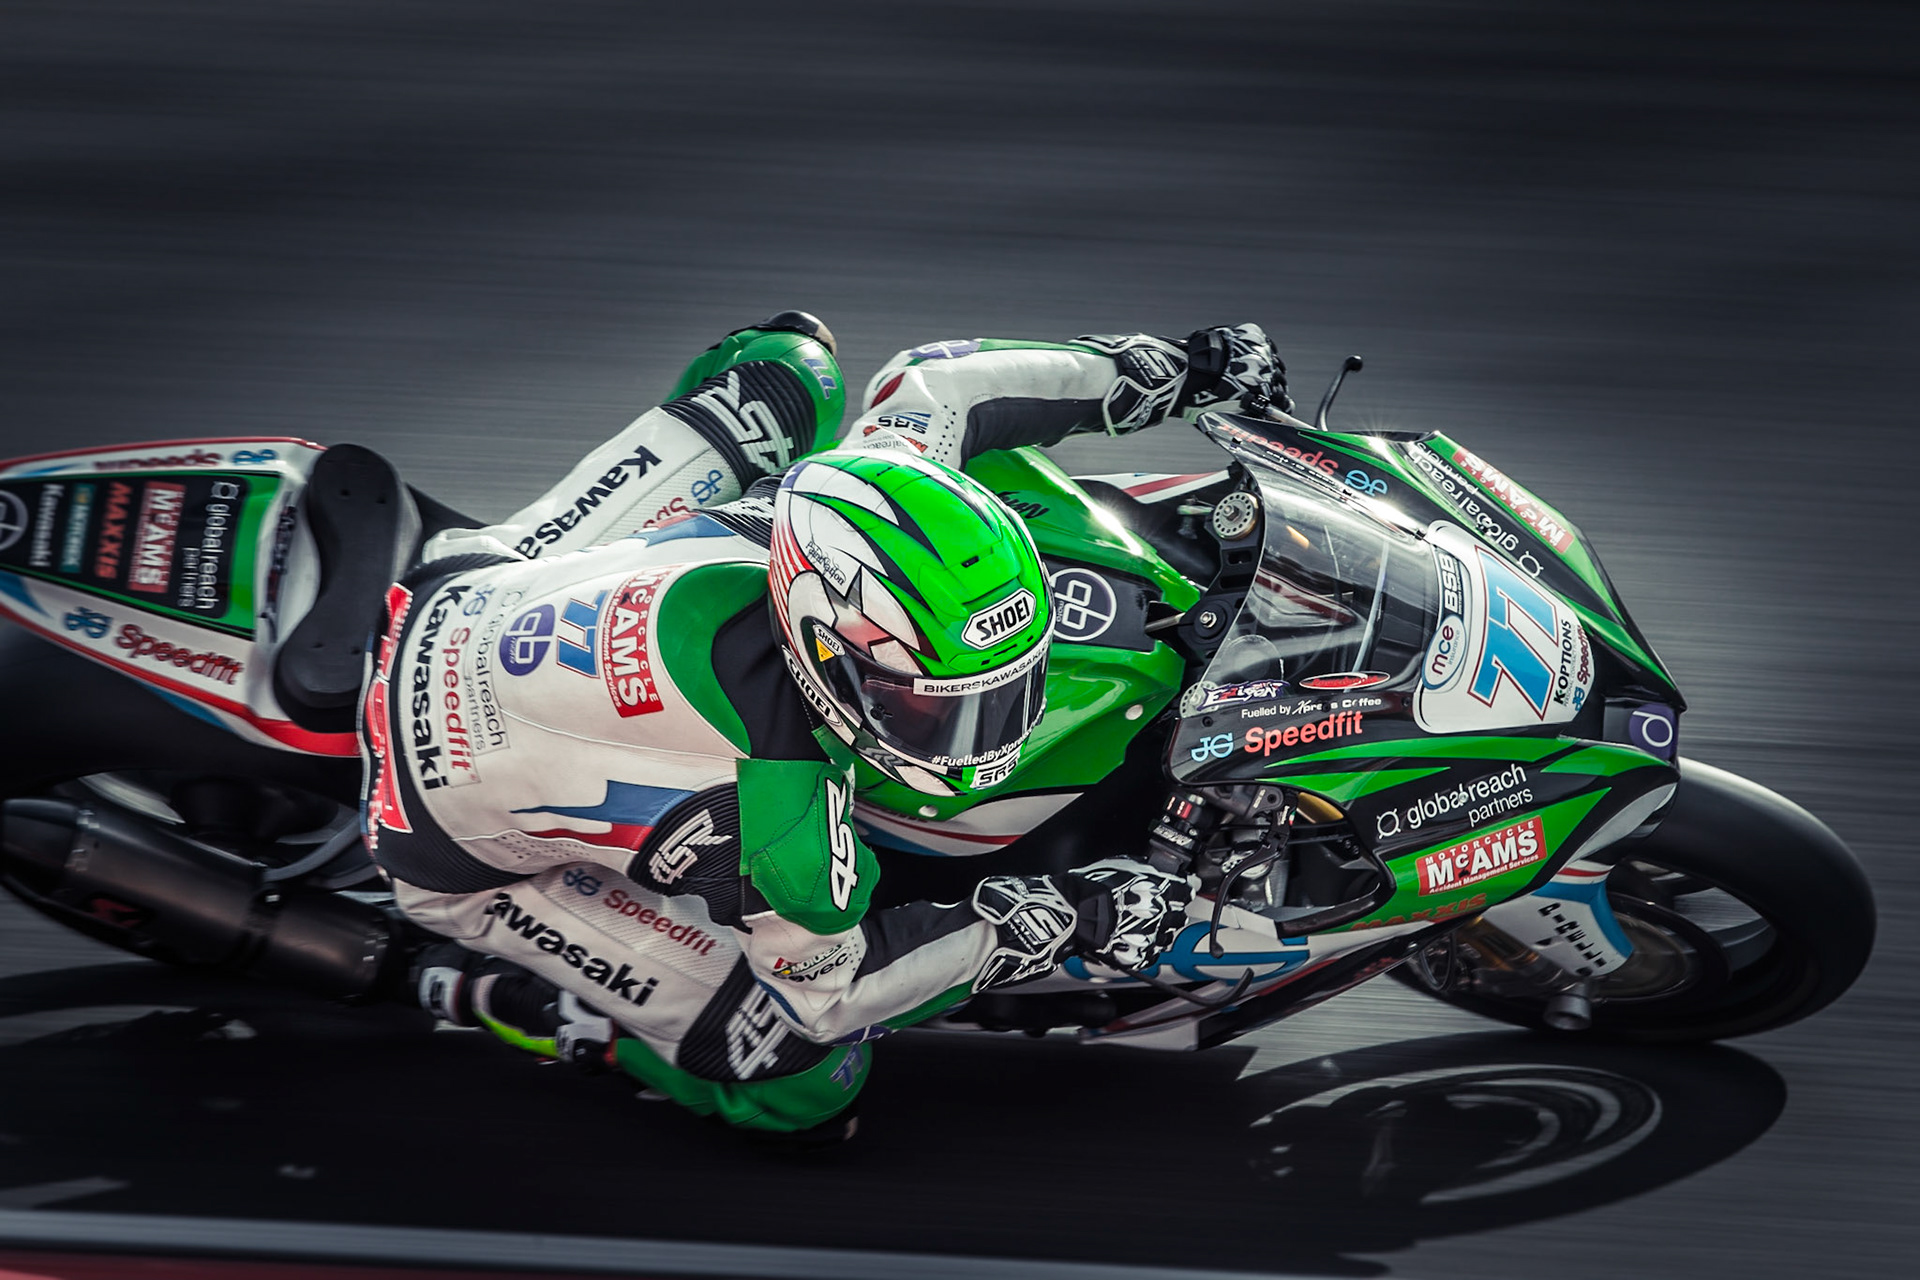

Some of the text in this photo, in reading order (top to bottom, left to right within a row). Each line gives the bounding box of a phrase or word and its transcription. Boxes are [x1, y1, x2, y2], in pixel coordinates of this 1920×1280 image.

[93, 481, 133, 580] MAXXIS
[514, 445, 662, 560] Kawasa
[1439, 552, 1460, 614] BSB
[556, 589, 613, 680] 77
[818, 628, 841, 652] SHOEI
[975, 597, 1030, 642] SHOEI
[1431, 625, 1454, 675] mce
[1467, 545, 1559, 722] 77
[115, 623, 245, 685] Speedfit
[413, 586, 472, 790] Kawasaki
[442, 627, 472, 771] Speedfit
[1241, 705, 1277, 719] Fuelled
[1279, 704, 1292, 717] by
[1291, 700, 1339, 715] Xpres
[1244, 711, 1364, 757] Speedfit
[1468, 788, 1534, 828] partners
[1425, 820, 1535, 866] MOTORCYCLE
[1429, 854, 1540, 895] Accident Management Services
[484, 892, 660, 1007] awasaki
[603, 889, 718, 956] Speedfit
